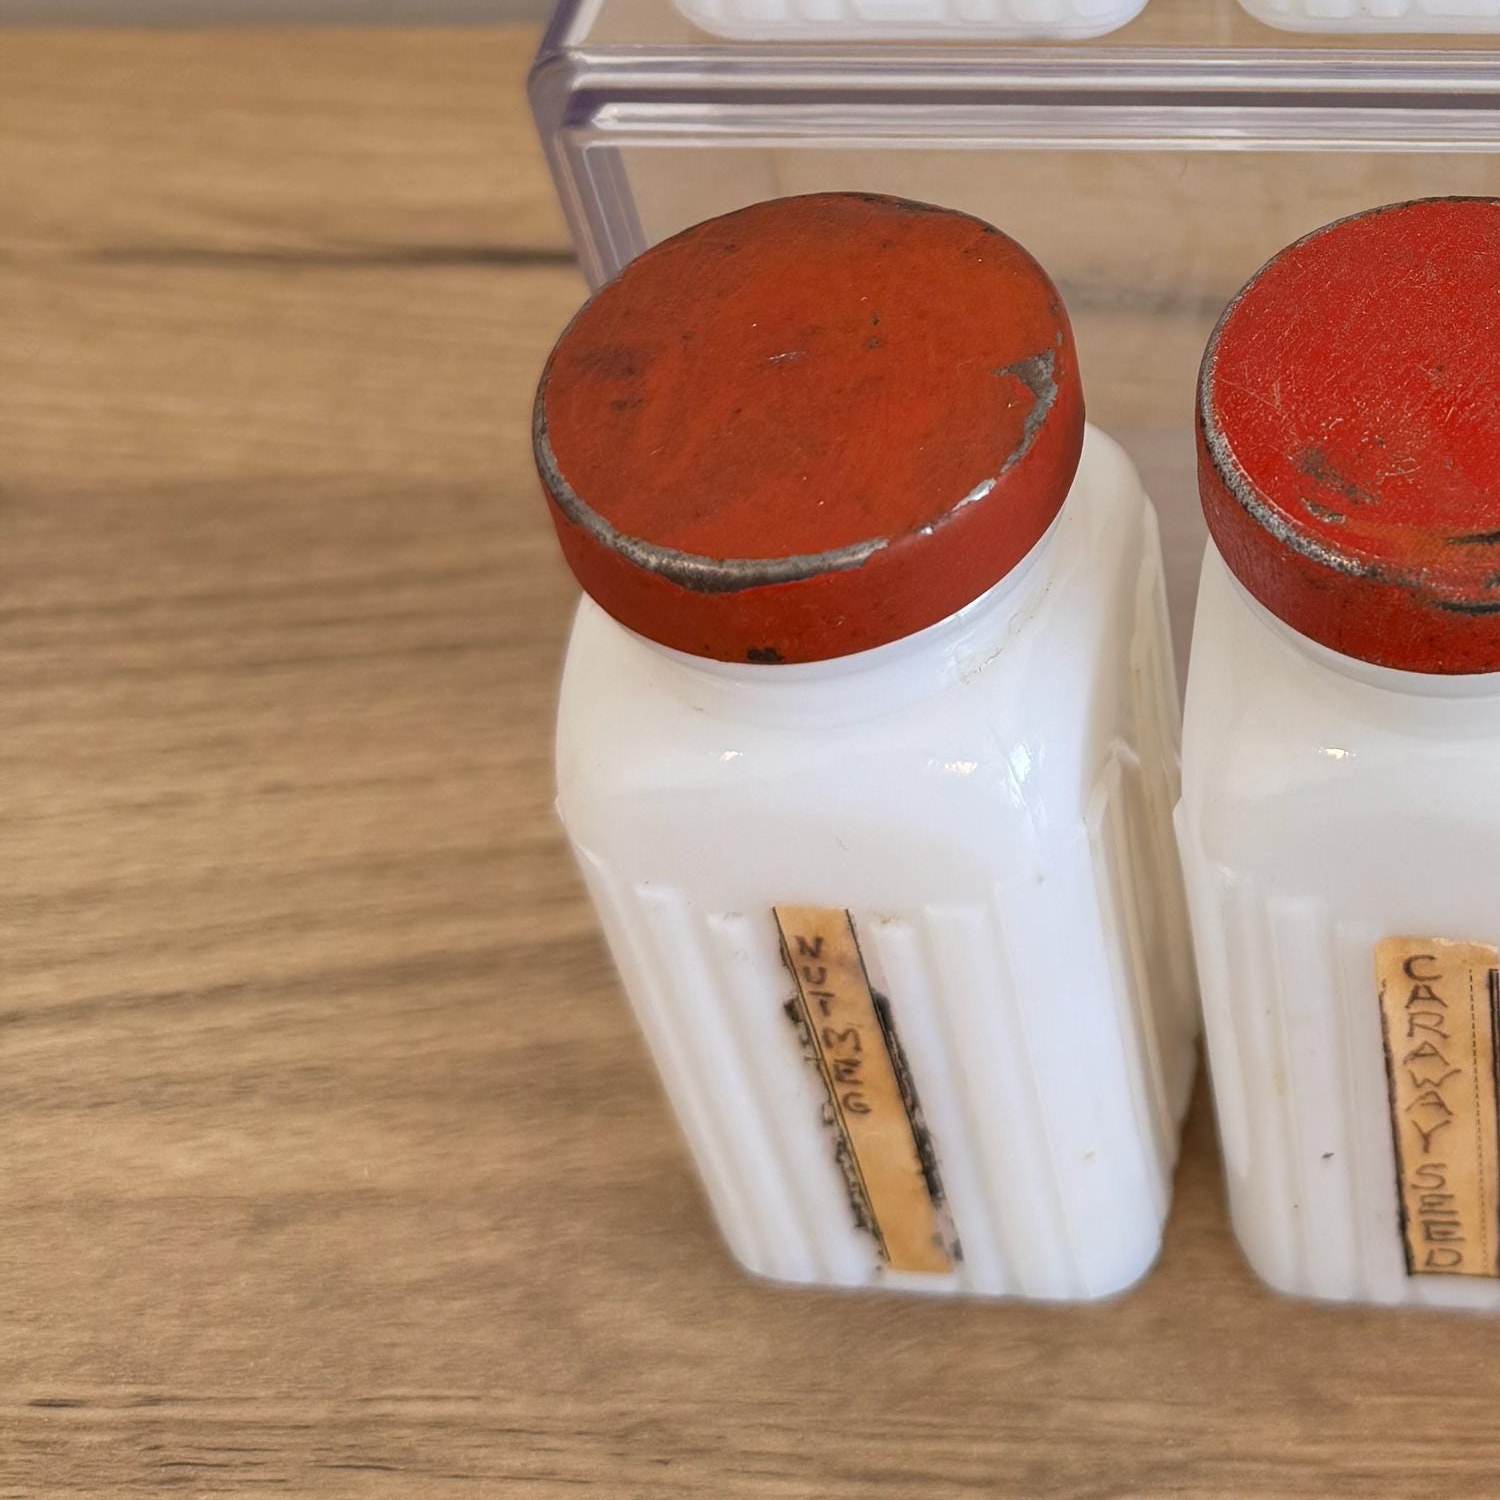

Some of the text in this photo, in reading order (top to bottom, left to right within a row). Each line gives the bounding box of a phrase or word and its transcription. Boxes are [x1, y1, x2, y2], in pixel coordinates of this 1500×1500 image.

[795, 935, 871, 1114] NUTMEG
[1403, 954, 1465, 1268] CARAWAY SEED
